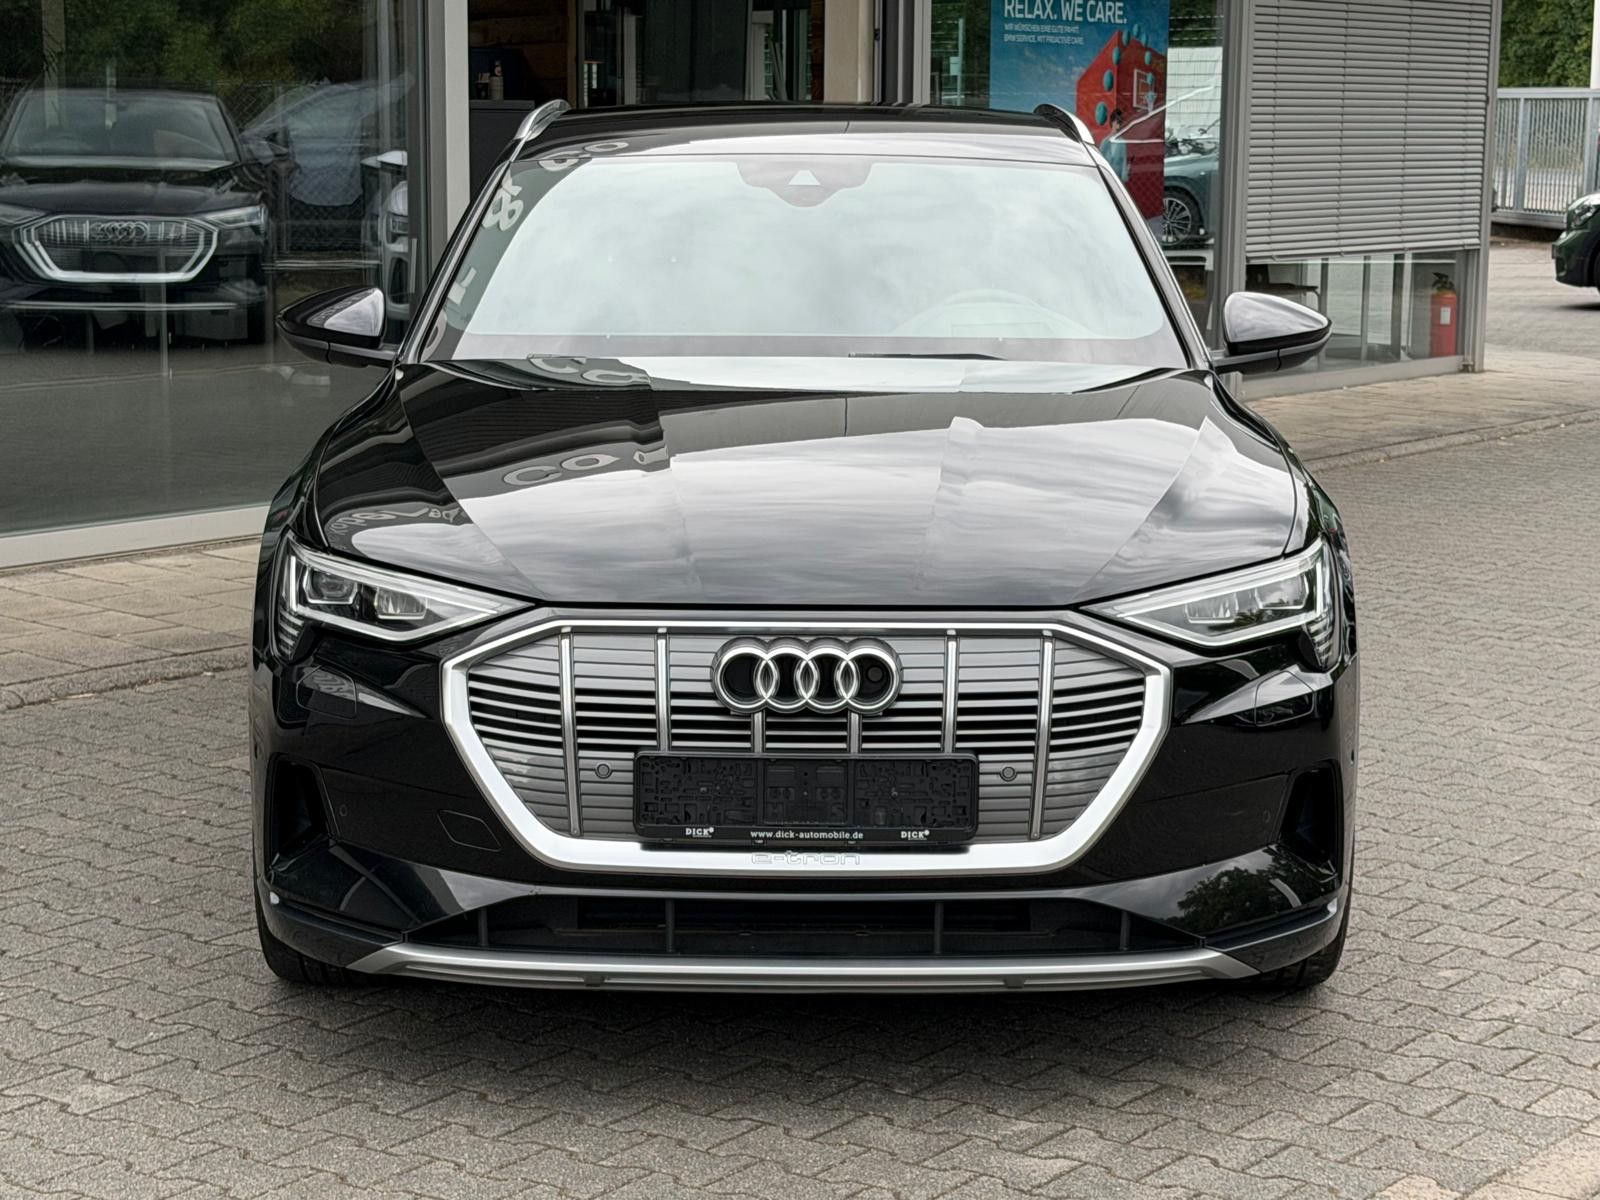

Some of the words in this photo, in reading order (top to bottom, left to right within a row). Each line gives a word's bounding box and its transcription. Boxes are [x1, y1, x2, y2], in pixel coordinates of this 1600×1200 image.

[1004, 0, 1057, 20] RELAX.
[1061, 0, 1083, 21] WE
[1087, 1, 1128, 24] CARE.
[685, 828, 709, 836] DICK
[750, 829, 864, 840] www.dick-automobile.de
[900, 831, 925, 839] DICK
[751, 850, 860, 865] e-tron
